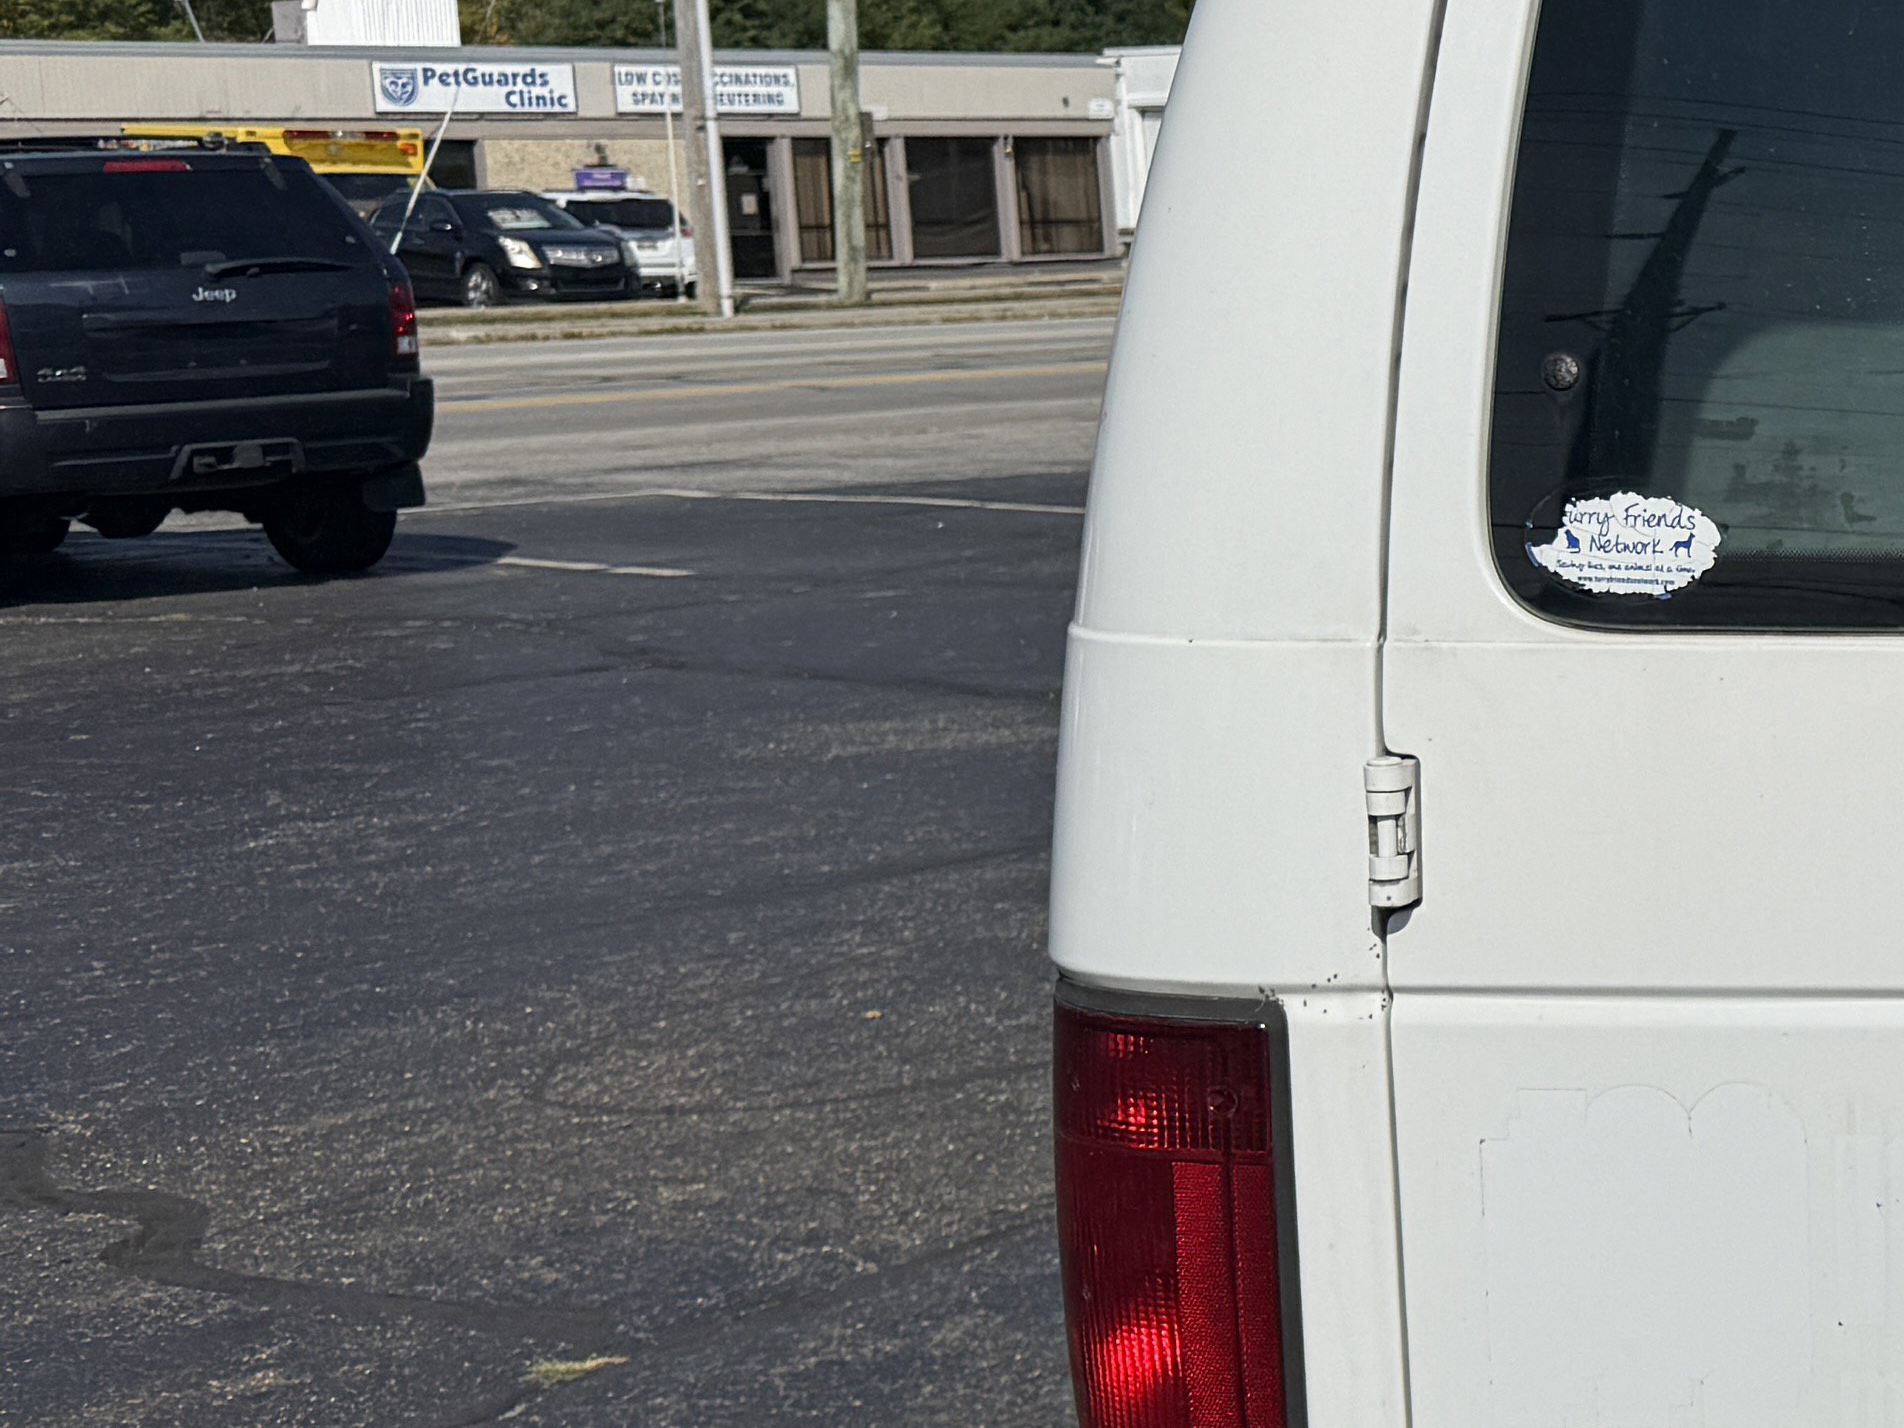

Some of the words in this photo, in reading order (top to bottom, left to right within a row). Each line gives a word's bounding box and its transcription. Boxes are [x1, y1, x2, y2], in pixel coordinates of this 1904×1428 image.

[421, 67, 550, 87] PetGuards
[617, 71, 648, 86] LOW
[505, 90, 569, 110] Clinic
[631, 92, 665, 105] SPAY
[191, 286, 238, 303] Jeep
[1566, 510, 1615, 537] urry
[1623, 502, 1696, 531] Friends
[1589, 533, 1664, 555] Network
